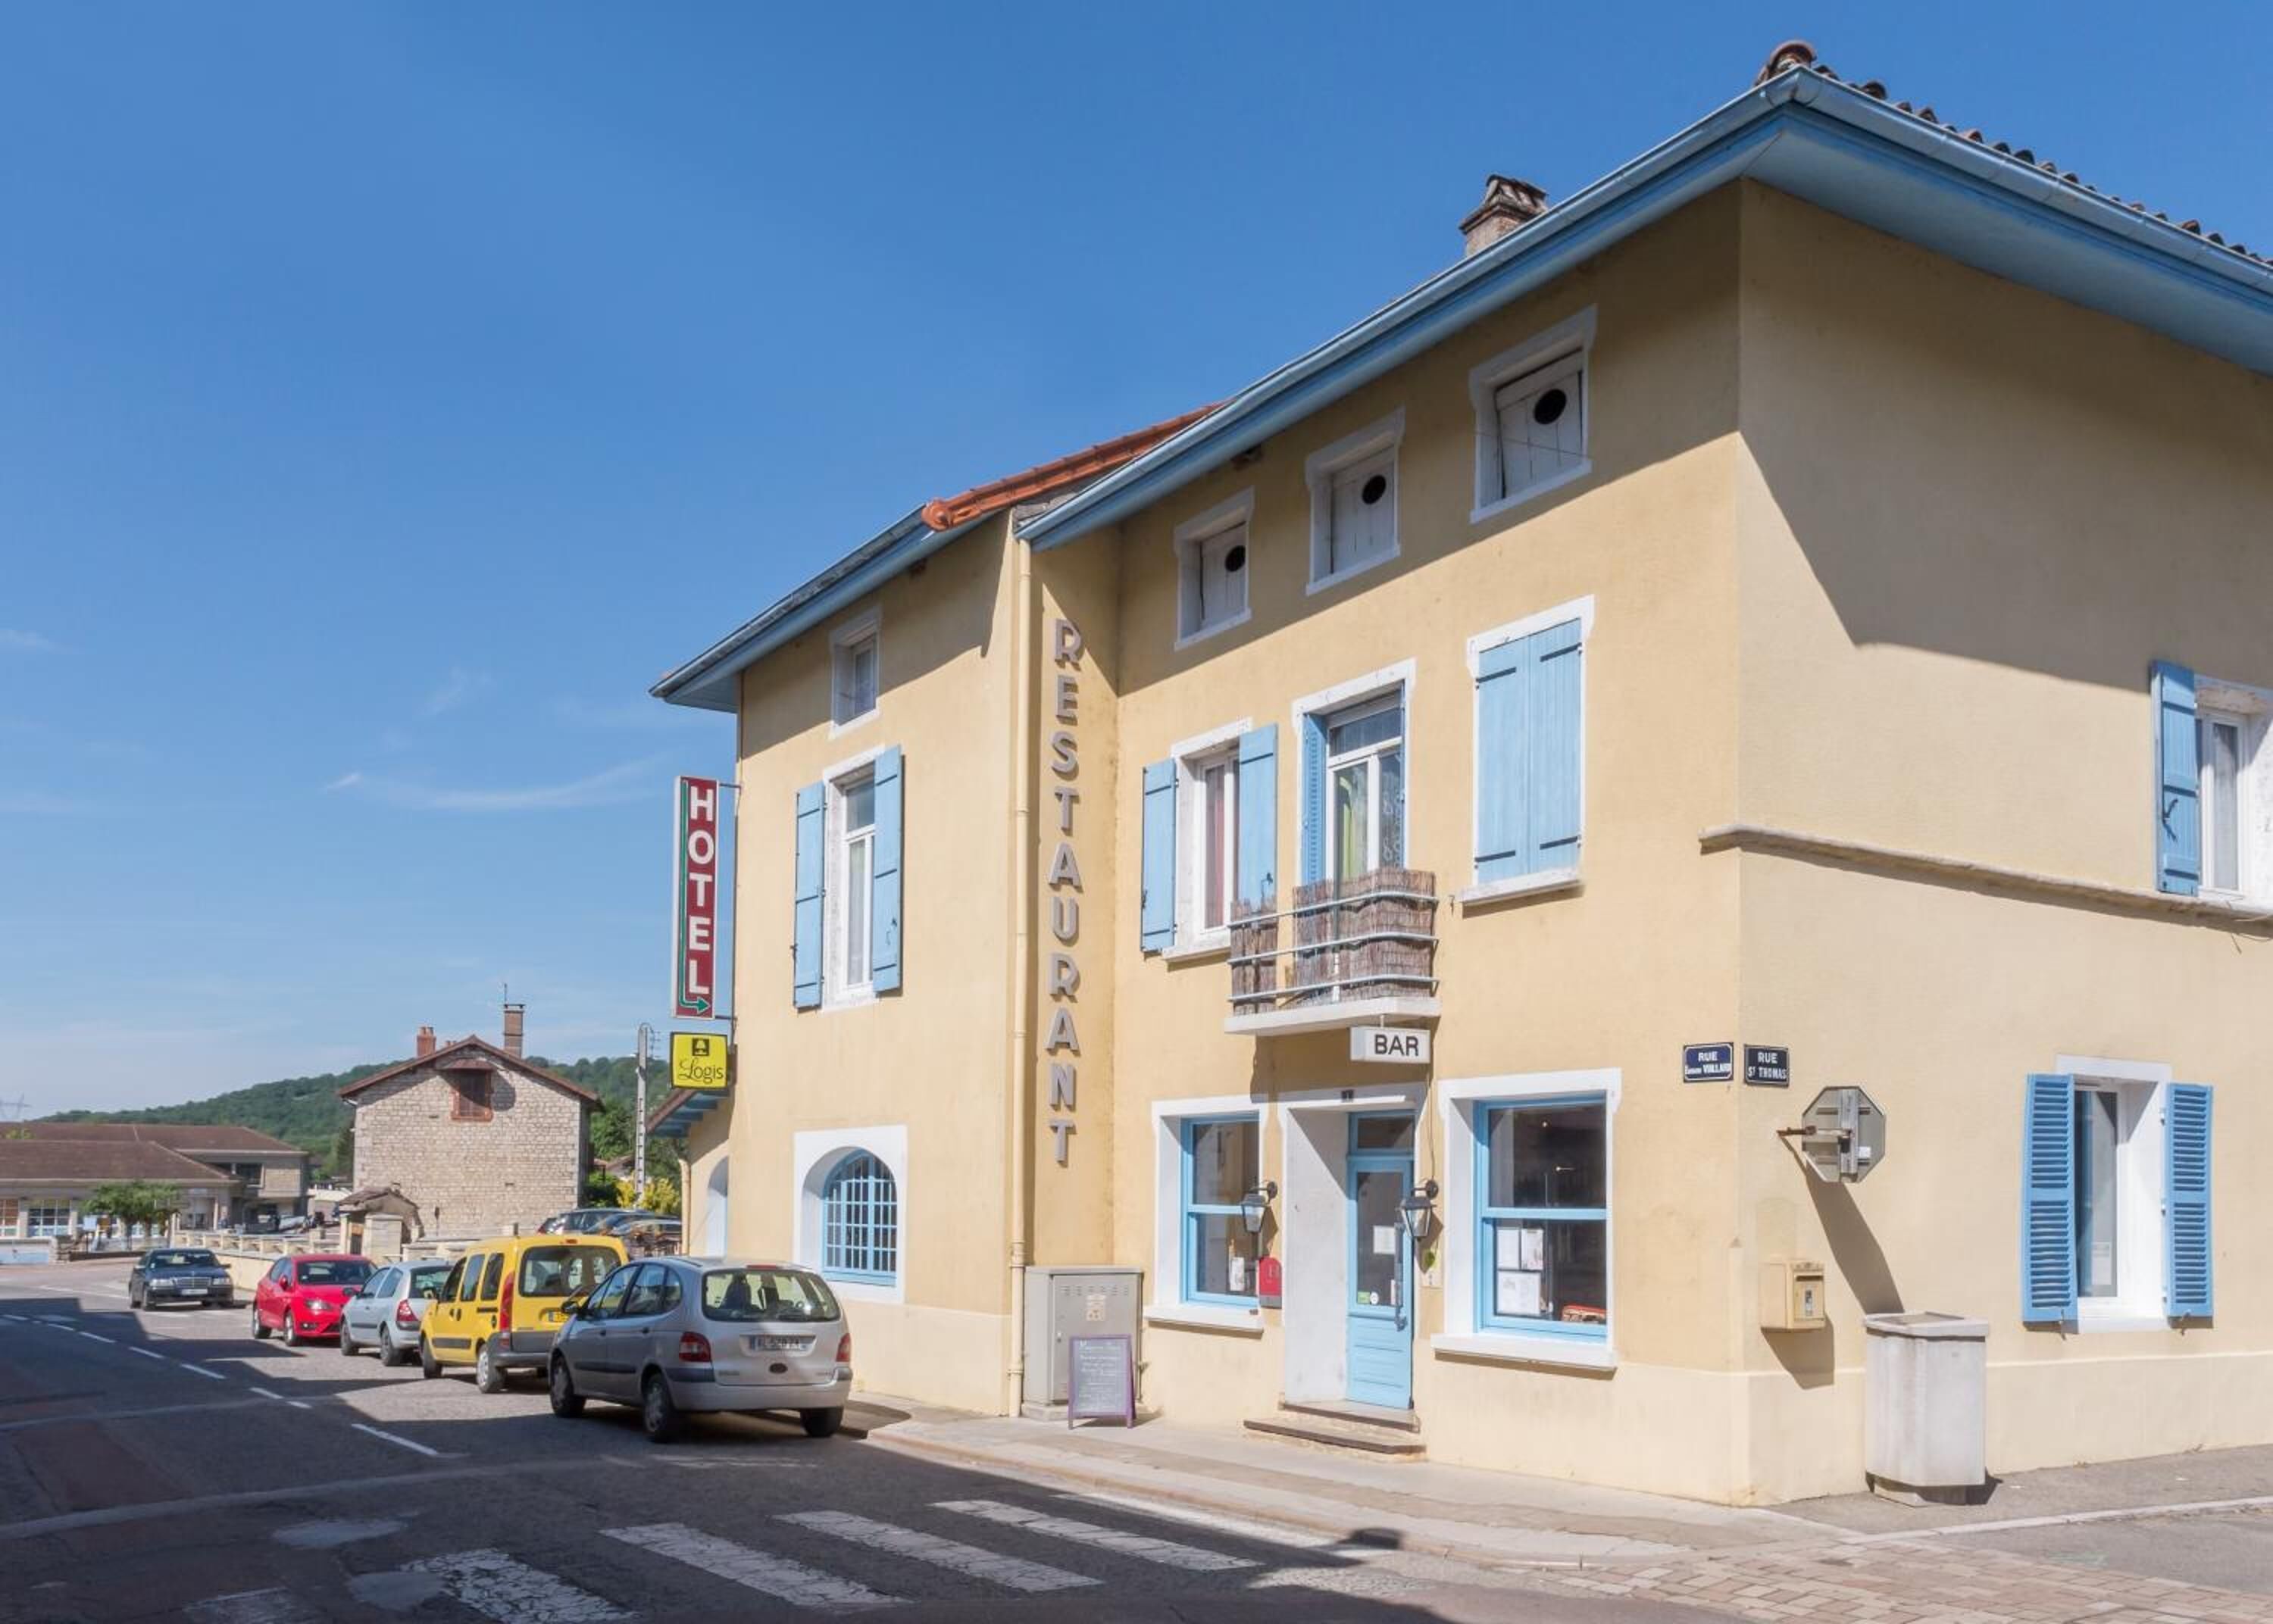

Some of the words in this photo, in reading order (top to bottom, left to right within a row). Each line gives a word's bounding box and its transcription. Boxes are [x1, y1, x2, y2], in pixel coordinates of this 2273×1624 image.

[687, 785, 714, 995] HOTEL
[1047, 617, 1081, 1162] RESTAURANT
[1374, 1034, 1419, 1057] BAR
[1698, 1051, 1718, 1062] RUE
[1757, 1052, 1778, 1064] RUE
[678, 1057, 724, 1085] Logis
[1759, 1067, 1787, 1079] THOMAS
